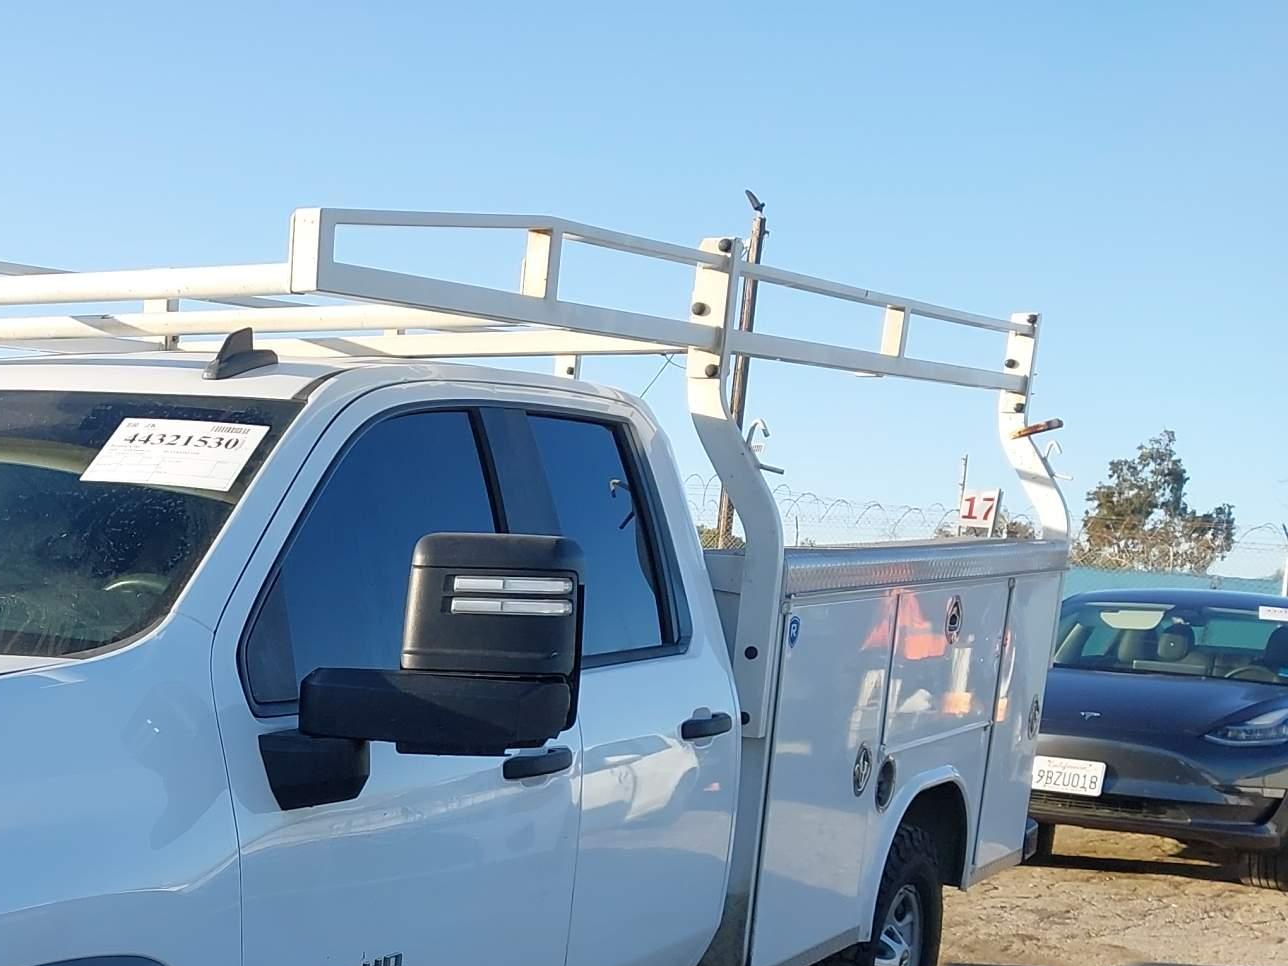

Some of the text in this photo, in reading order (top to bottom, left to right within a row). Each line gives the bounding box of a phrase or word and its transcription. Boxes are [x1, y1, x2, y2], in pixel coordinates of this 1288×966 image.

[124, 432, 240, 450] 44321530
[961, 496, 995, 521] 17
[1036, 769, 1099, 790] 9BZU018
